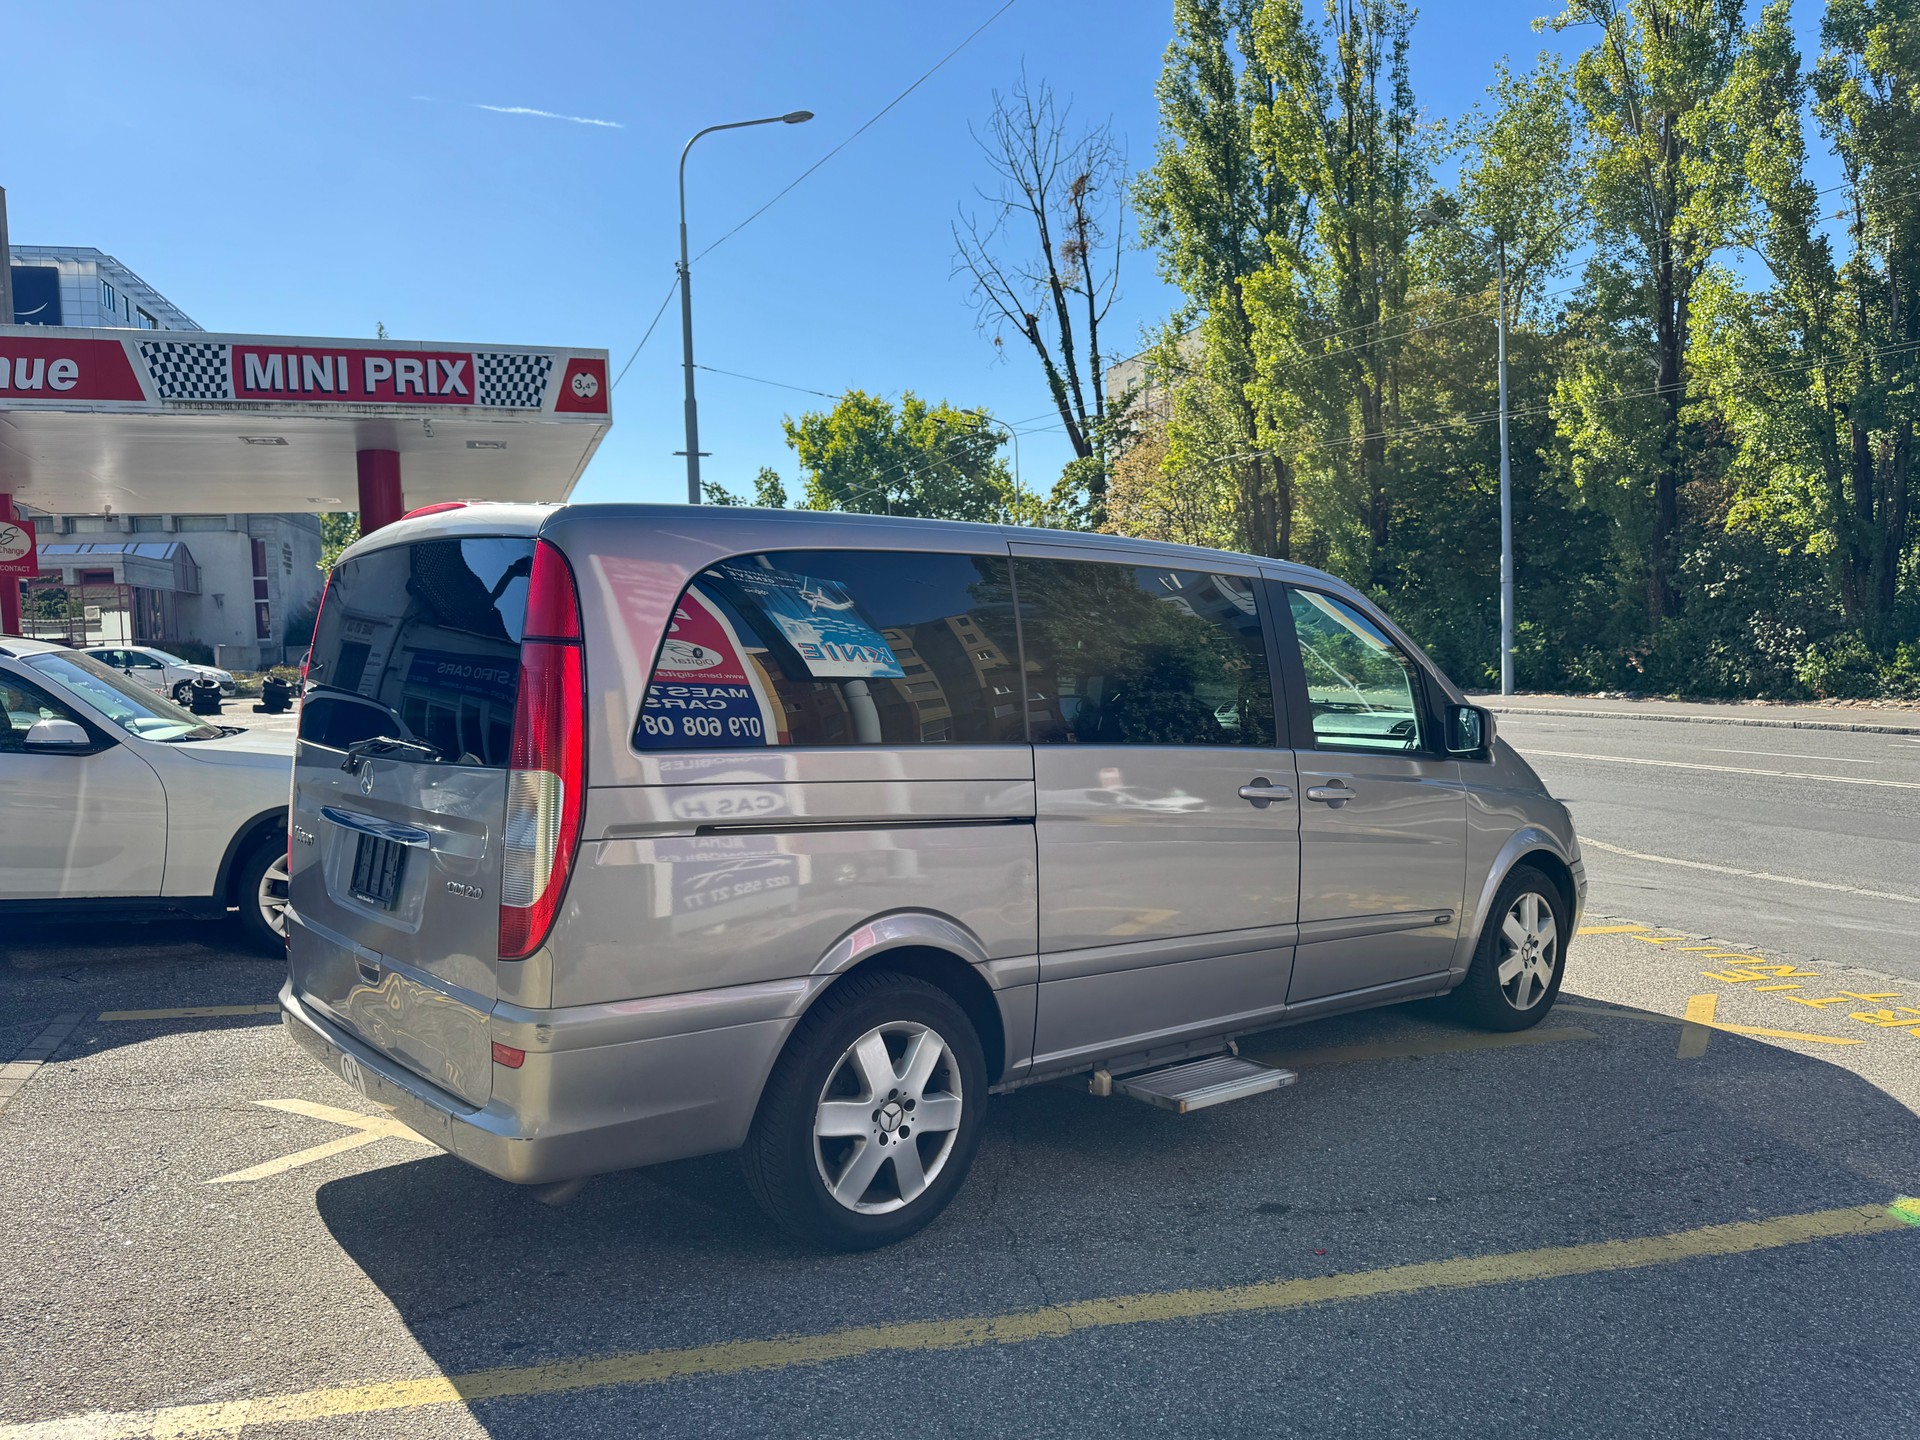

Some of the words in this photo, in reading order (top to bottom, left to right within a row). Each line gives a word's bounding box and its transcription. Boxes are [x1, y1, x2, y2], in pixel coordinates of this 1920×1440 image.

[243, 352, 348, 393] MINI
[363, 357, 469, 396] PRIX
[0, 565, 30, 573] CONTACT
[343, 1057, 364, 1096] CH
